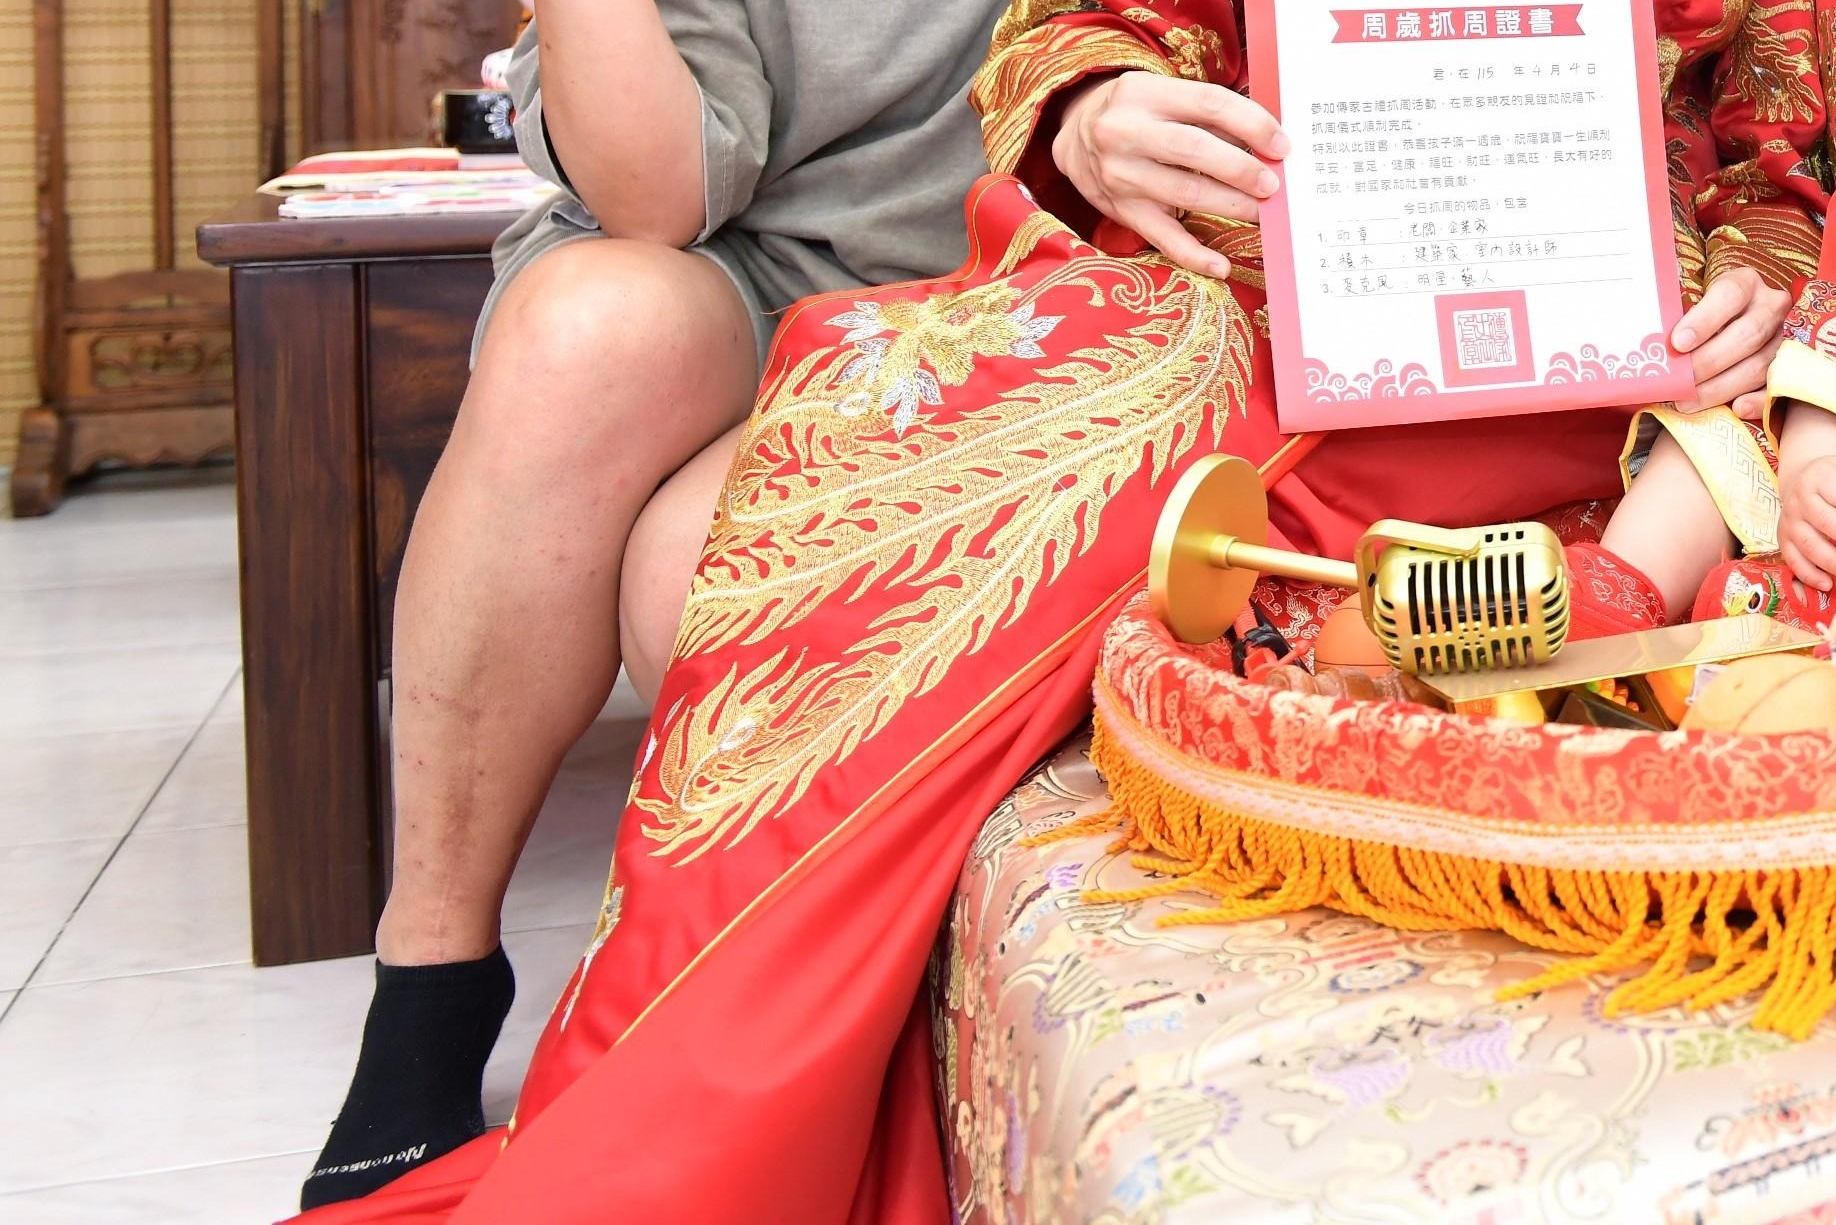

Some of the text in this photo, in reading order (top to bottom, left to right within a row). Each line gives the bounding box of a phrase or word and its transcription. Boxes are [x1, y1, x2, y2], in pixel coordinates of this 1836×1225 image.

[1361, 8, 1555, 40] 周歲抓周證書
[1336, 226, 1369, 245] 印章
[1343, 274, 1394, 295] 麥克風
